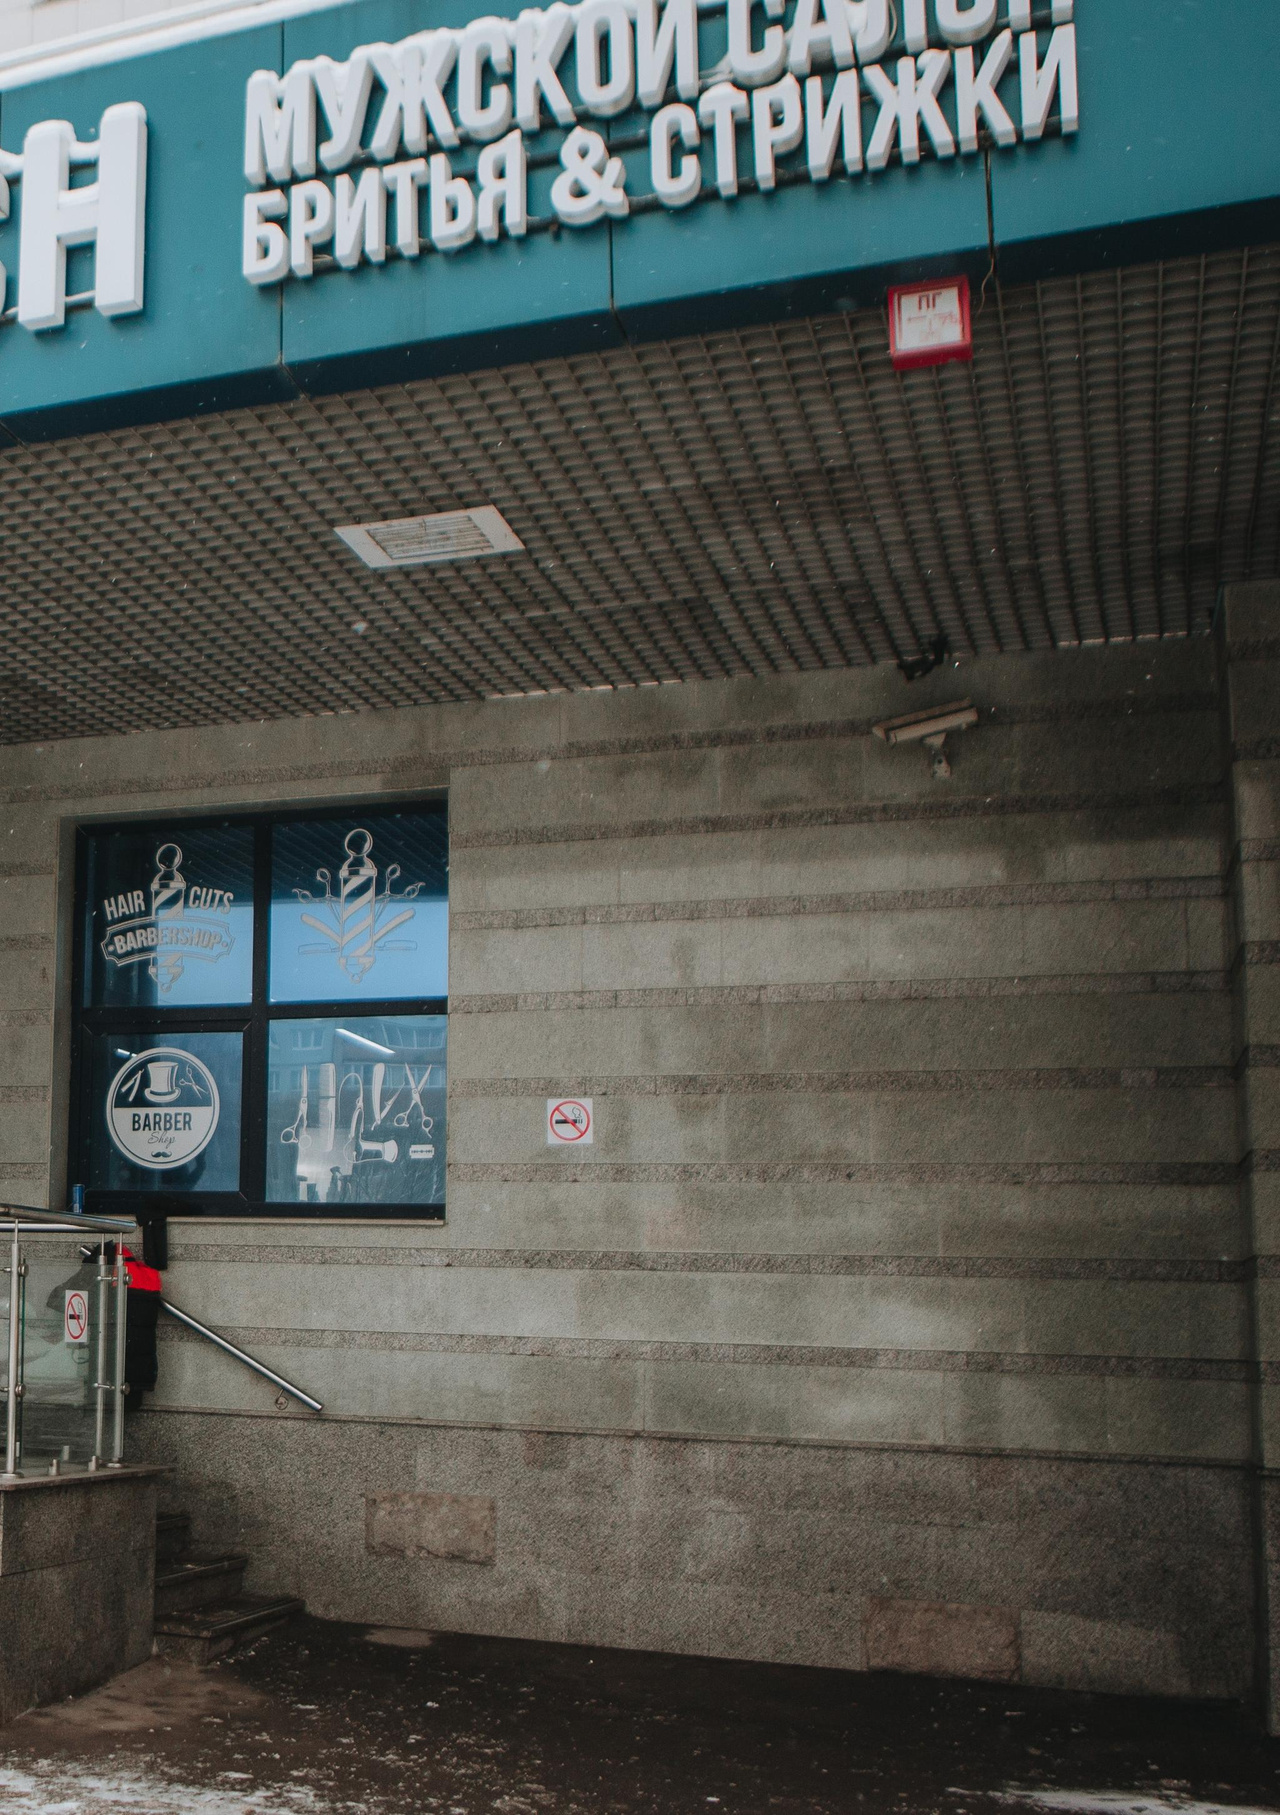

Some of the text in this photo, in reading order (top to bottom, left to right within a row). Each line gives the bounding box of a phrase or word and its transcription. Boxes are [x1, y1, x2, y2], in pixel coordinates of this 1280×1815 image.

[243, 22, 1079, 286] БРИТЬЯ & СТРИЖКИ
[104, 886, 234, 920] HAIR CUTS
[113, 926, 222, 954] BARBERSHOP
[132, 1112, 192, 1131] BARBER
[147, 1130, 176, 1149] Shop
